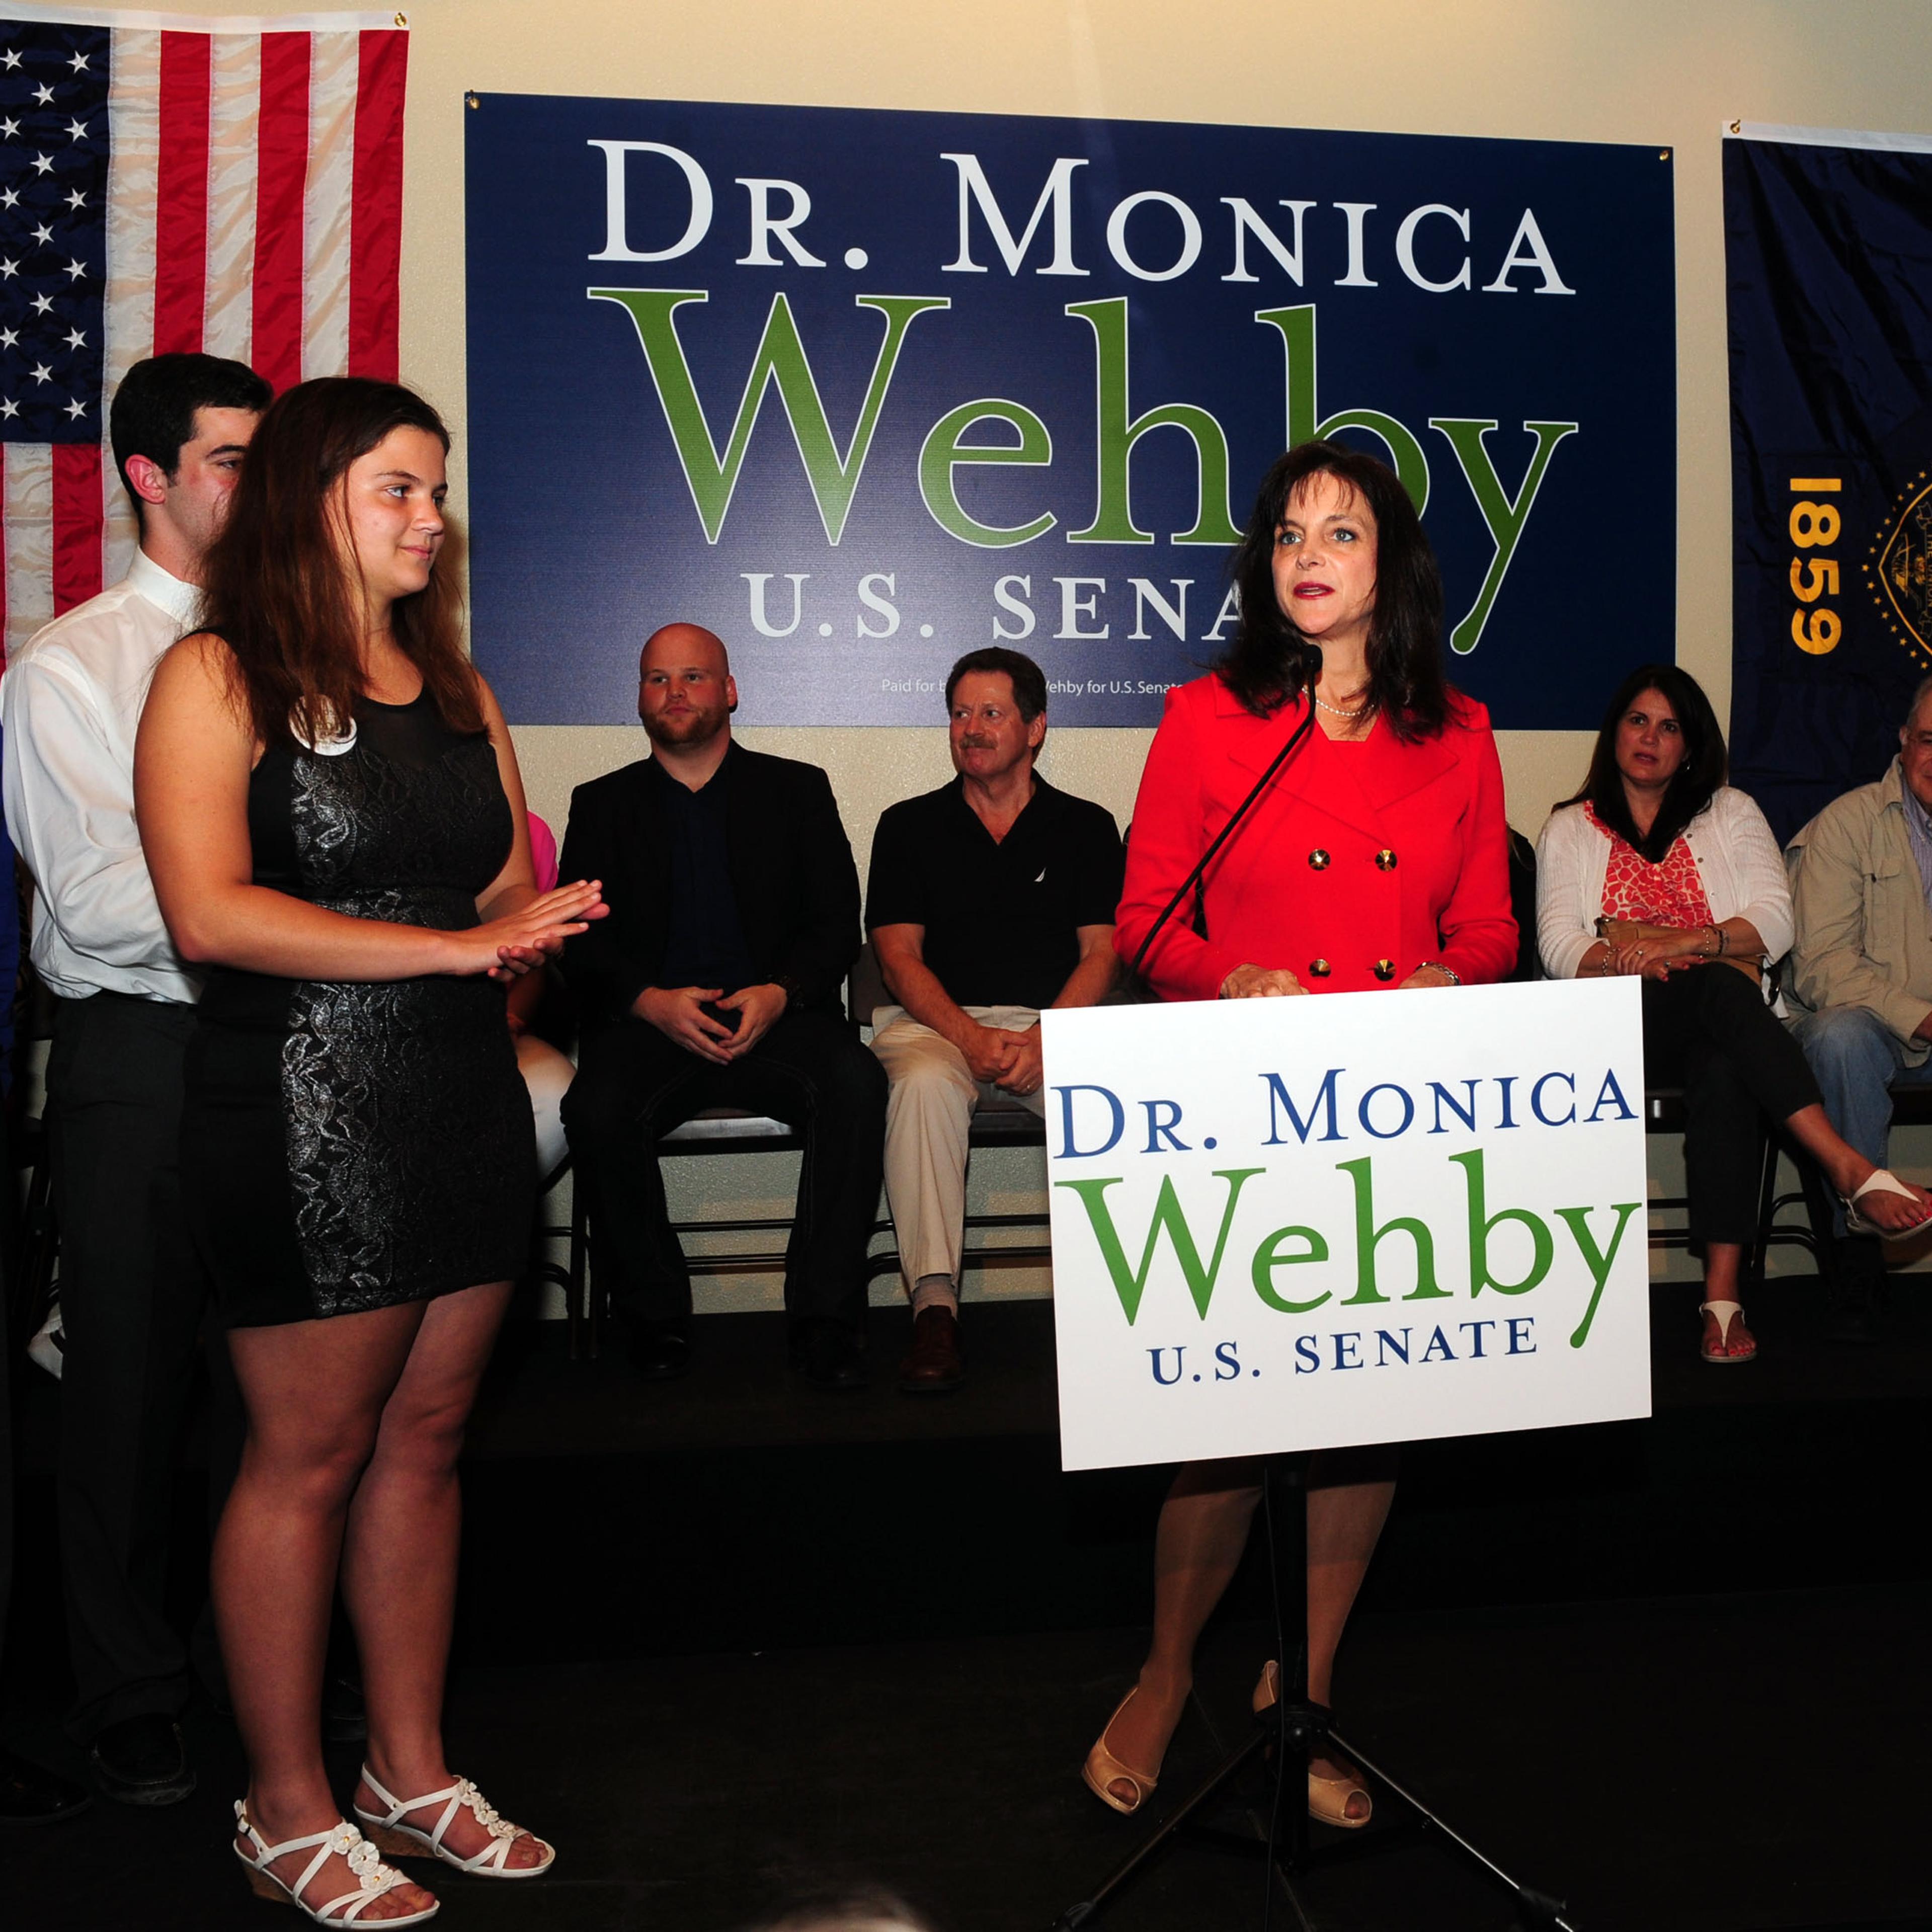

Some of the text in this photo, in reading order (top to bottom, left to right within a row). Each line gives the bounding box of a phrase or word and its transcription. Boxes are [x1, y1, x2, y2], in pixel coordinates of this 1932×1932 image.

[940, 152, 1576, 296] MONICA
[587, 287, 1579, 655] Wehby
[740, 573, 1243, 640] U.S. SENA
[1789, 478, 1842, 655] 1859
[882, 679, 1183, 696] Paid for b ehby for U.S. Sena
[1258, 1068, 1639, 1146] MONICA
[1054, 1148, 1643, 1350] Wehby
[1146, 1317, 1538, 1386] U.S. SENATE
